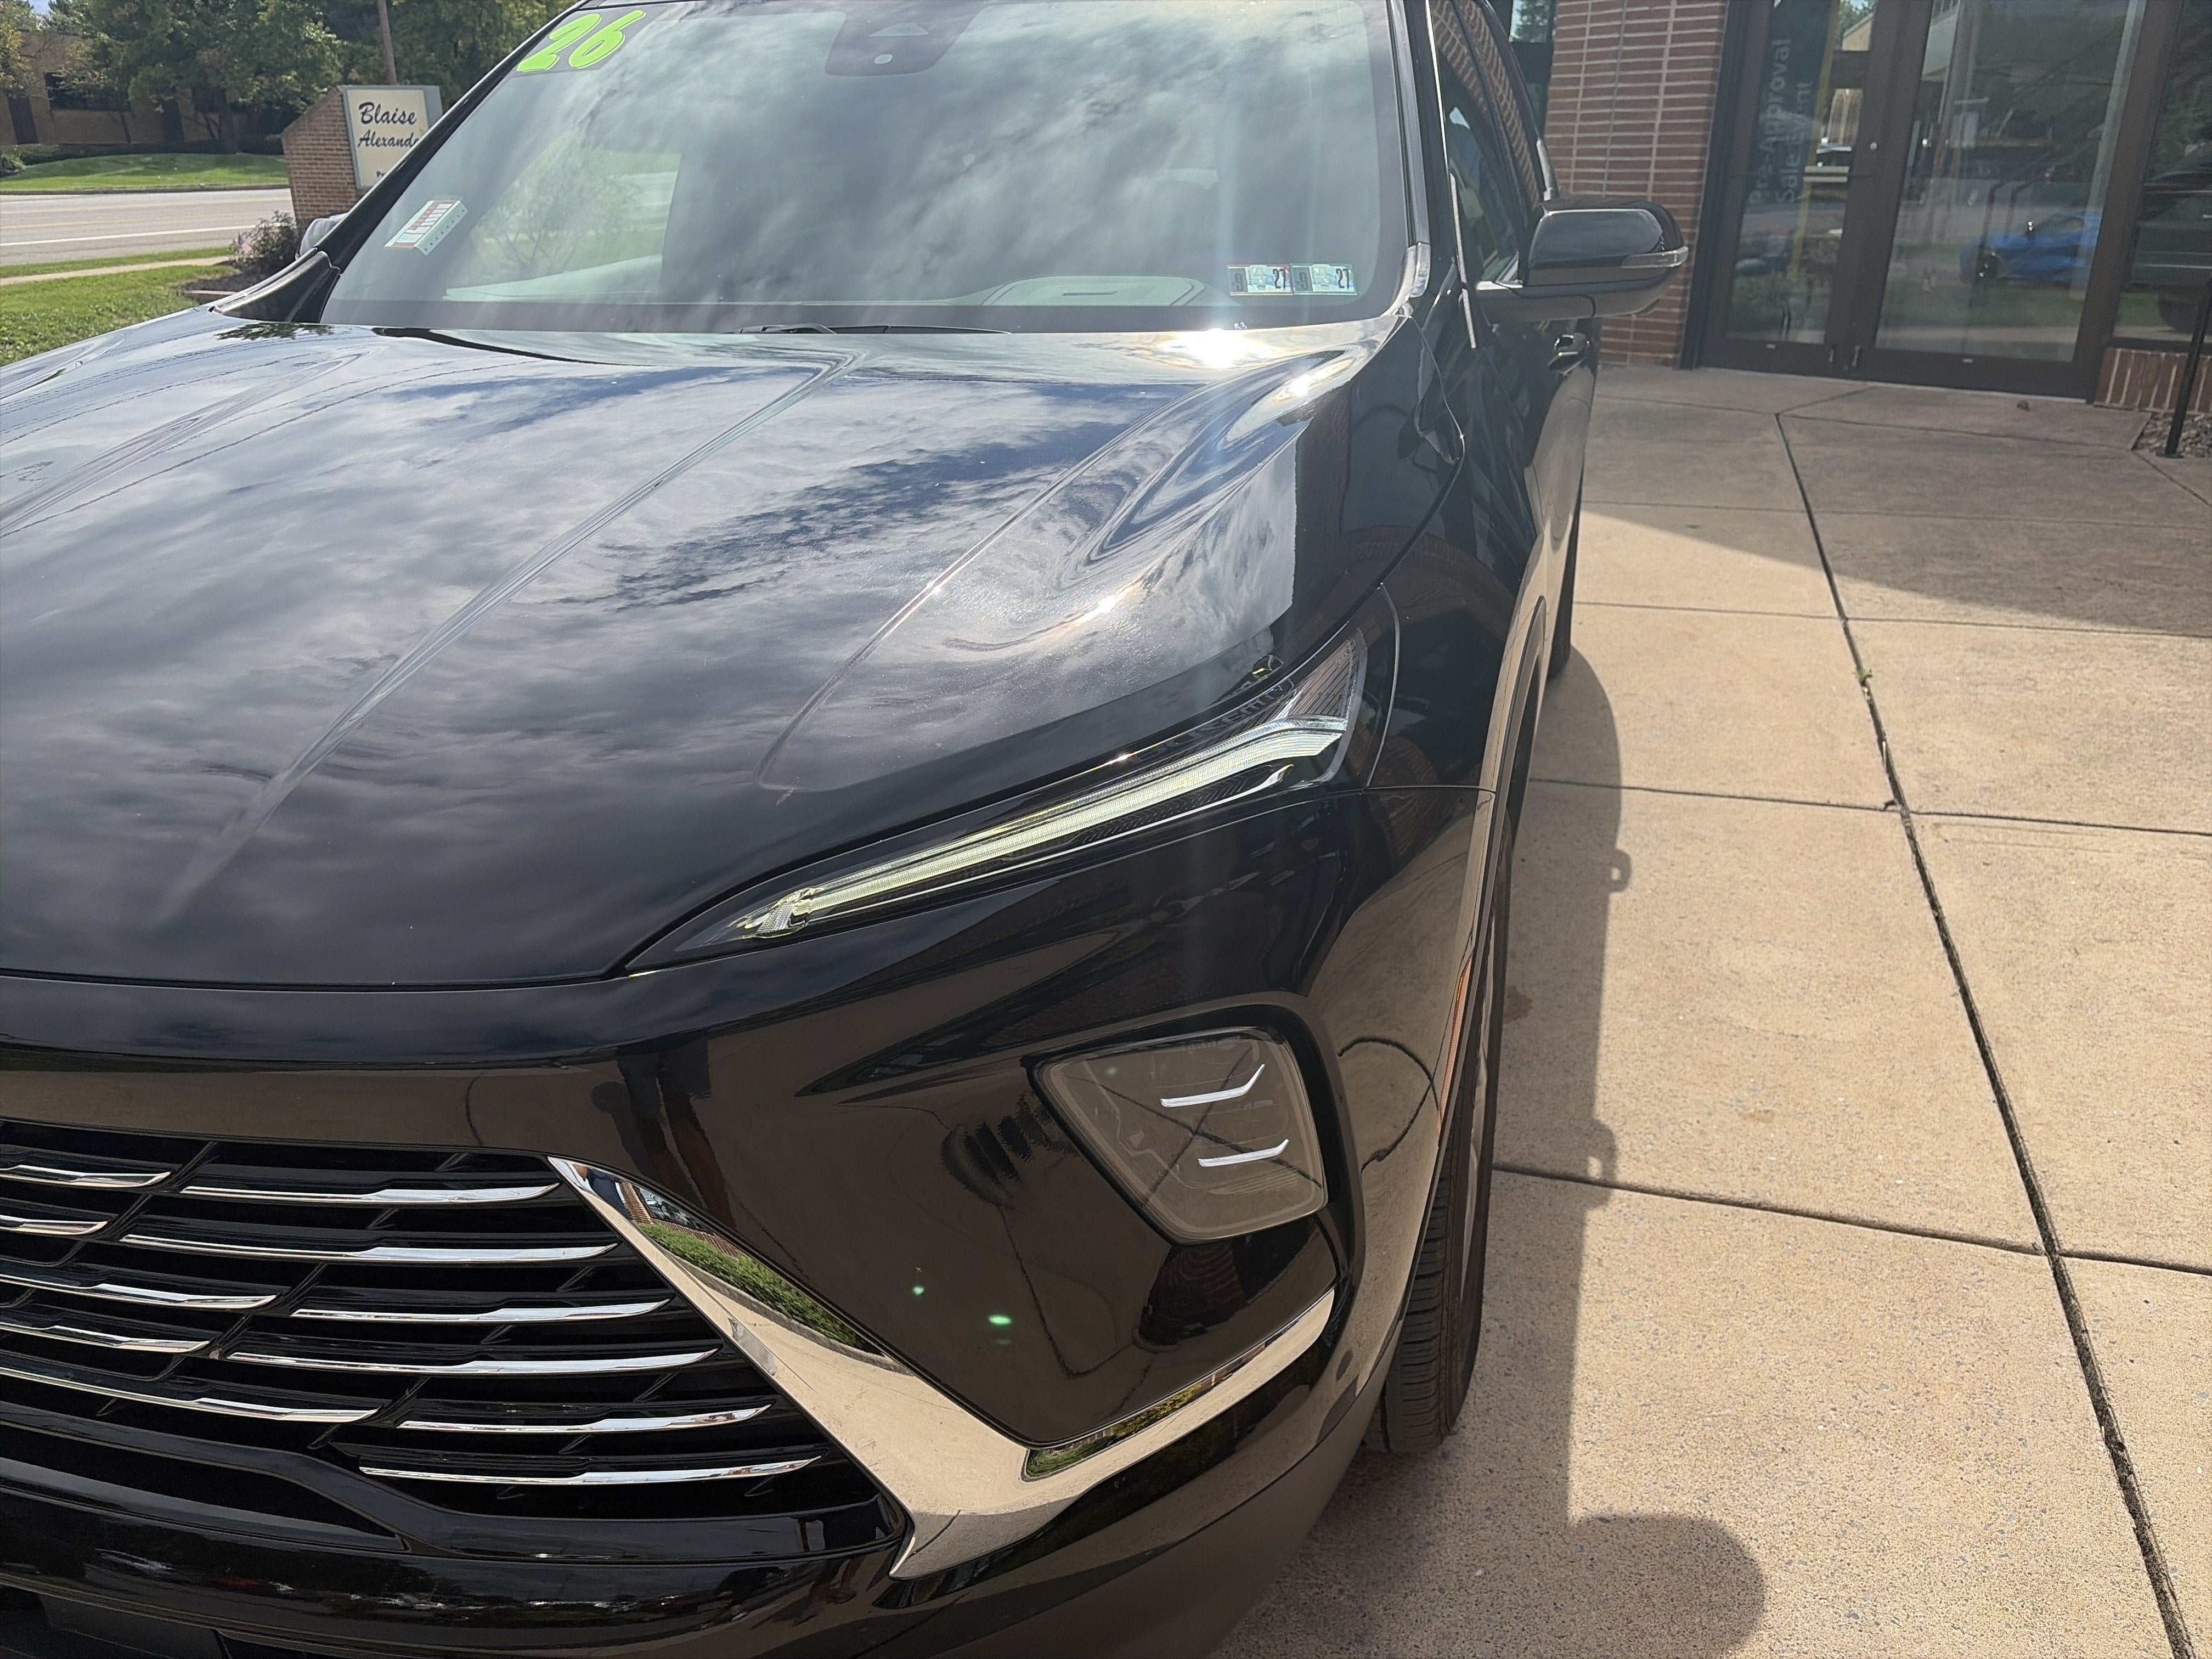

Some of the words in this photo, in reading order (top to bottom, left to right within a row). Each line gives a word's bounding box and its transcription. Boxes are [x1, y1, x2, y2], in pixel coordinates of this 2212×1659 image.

[516, 9, 646, 72] 26
[358, 101, 417, 125] Blaise
[1273, 268, 1286, 289] 27
[1336, 268, 1350, 289] 27
